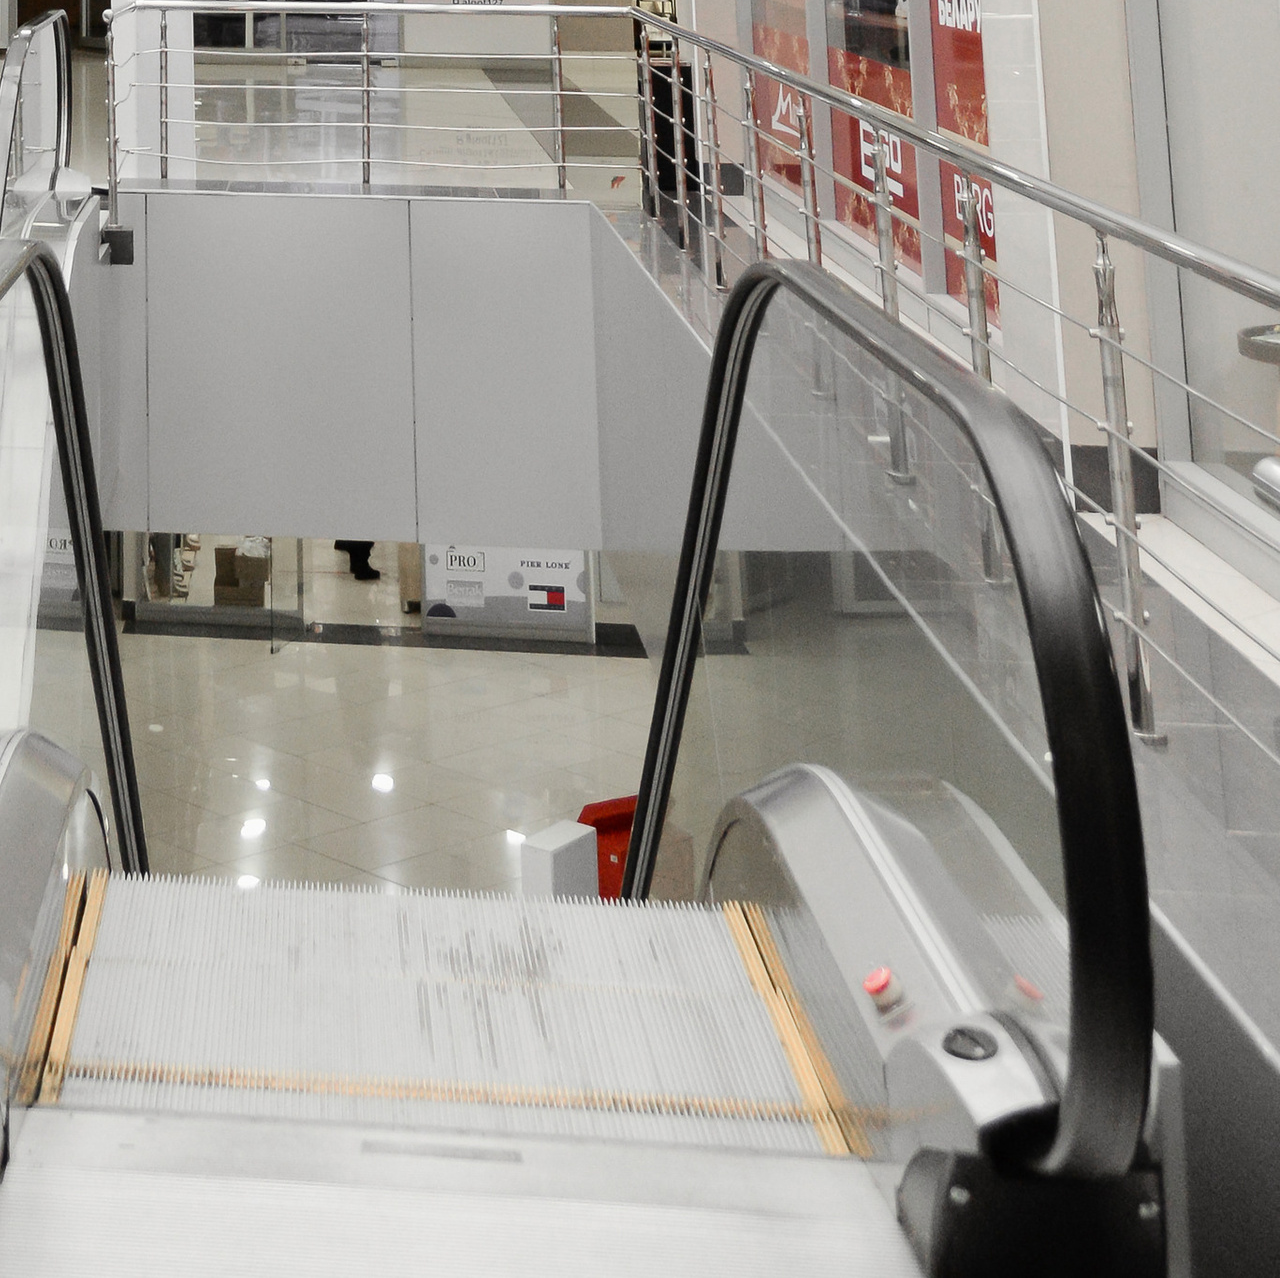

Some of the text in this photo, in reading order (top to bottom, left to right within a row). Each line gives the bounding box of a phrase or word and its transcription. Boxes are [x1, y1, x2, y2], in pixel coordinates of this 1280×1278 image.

[953, 173, 994, 238] BRG
[449, 554, 477, 568] PRO
[520, 560, 542, 569] PIER
